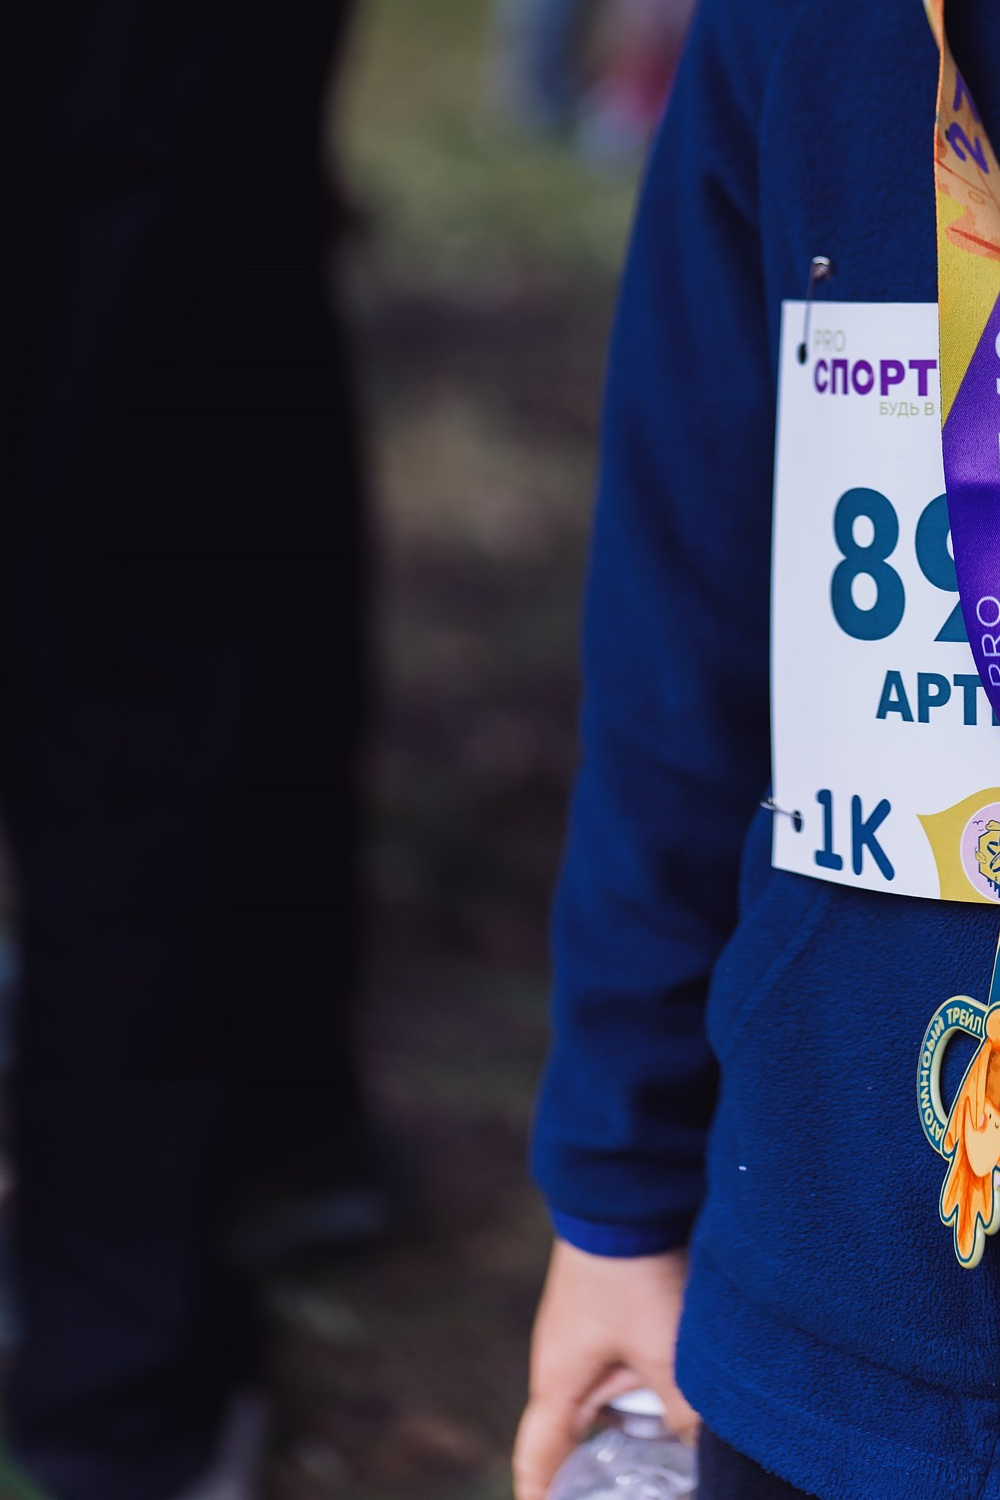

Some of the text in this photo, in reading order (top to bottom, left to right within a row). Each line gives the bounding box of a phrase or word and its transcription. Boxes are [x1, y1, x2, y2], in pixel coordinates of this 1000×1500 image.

[814, 358, 937, 396] СПОРТ
[879, 401, 920, 417] БУДЬ
[946, 1006, 983, 1034] ТРЕЙЛ
